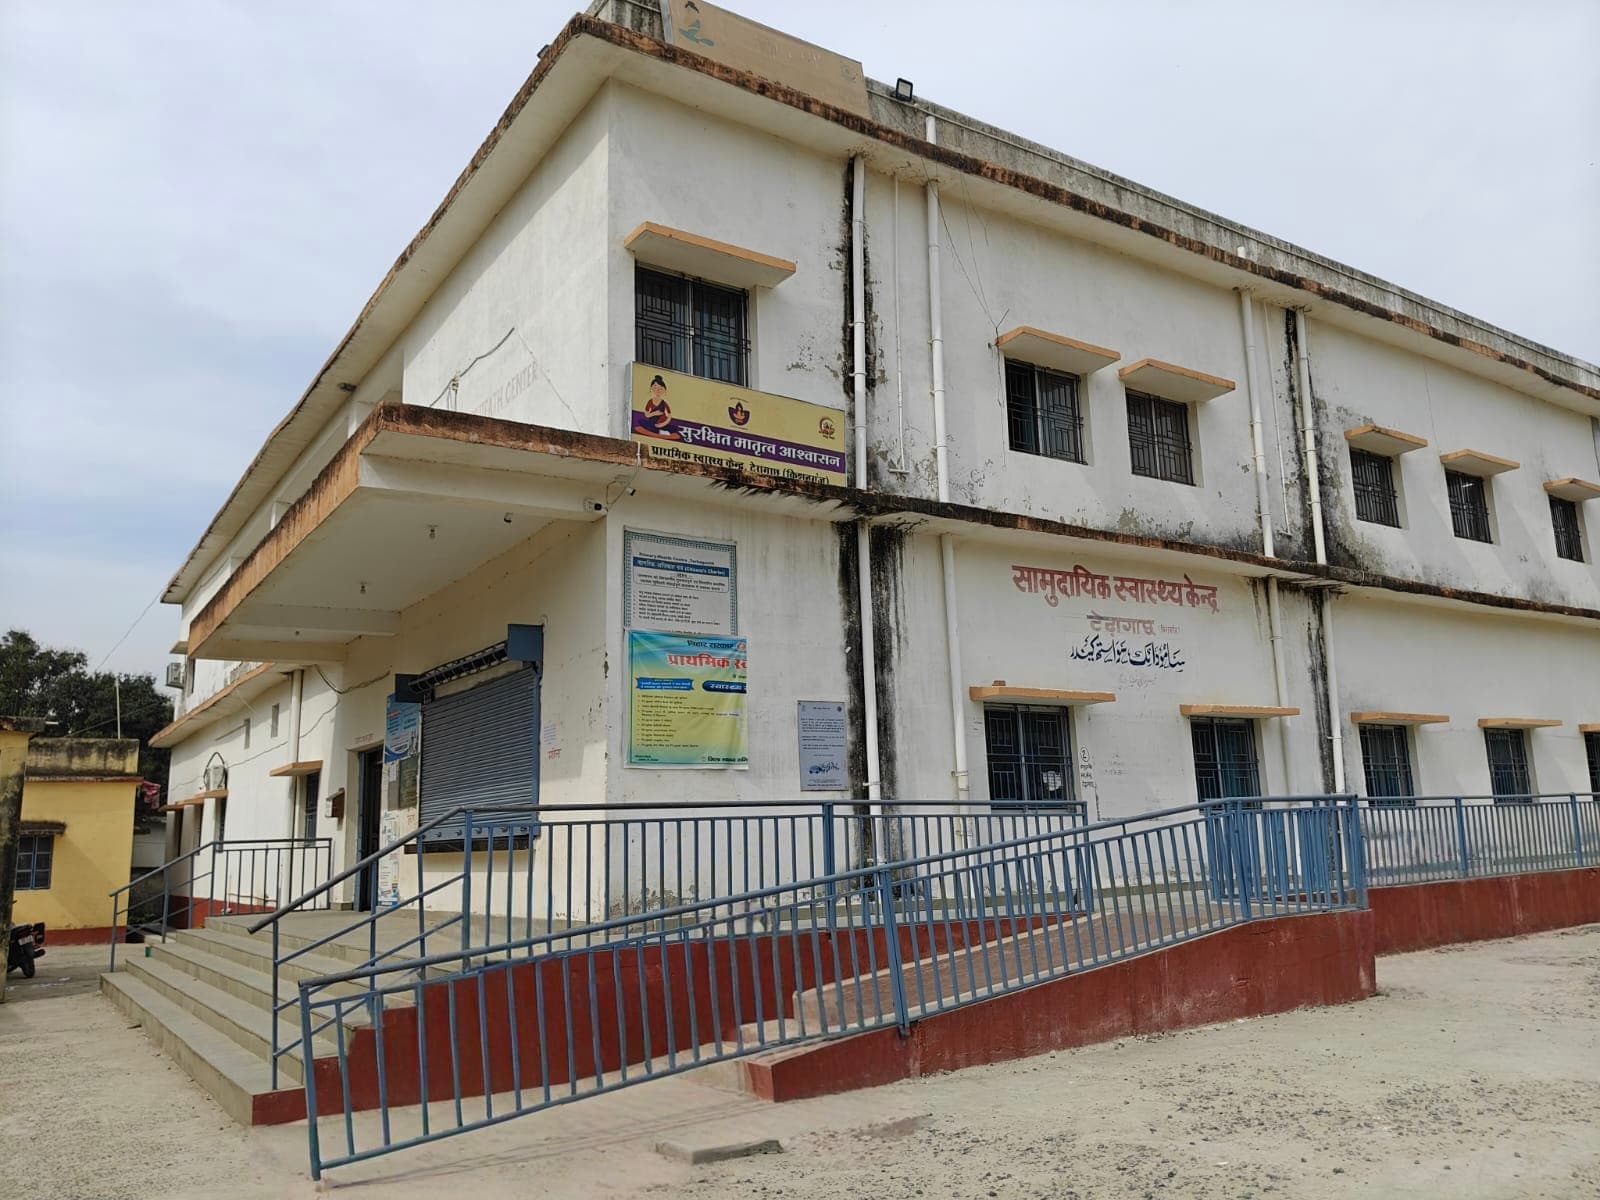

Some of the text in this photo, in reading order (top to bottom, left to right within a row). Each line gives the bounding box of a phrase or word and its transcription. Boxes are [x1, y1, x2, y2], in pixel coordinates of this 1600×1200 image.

[678, 424, 840, 467] सुरक्षित मातृत्व आश्वासन
[1011, 565, 1220, 614] सामुदायिक स्वास्थ्य केन्द्र
[667, 652, 730, 669] प्राथमिक
